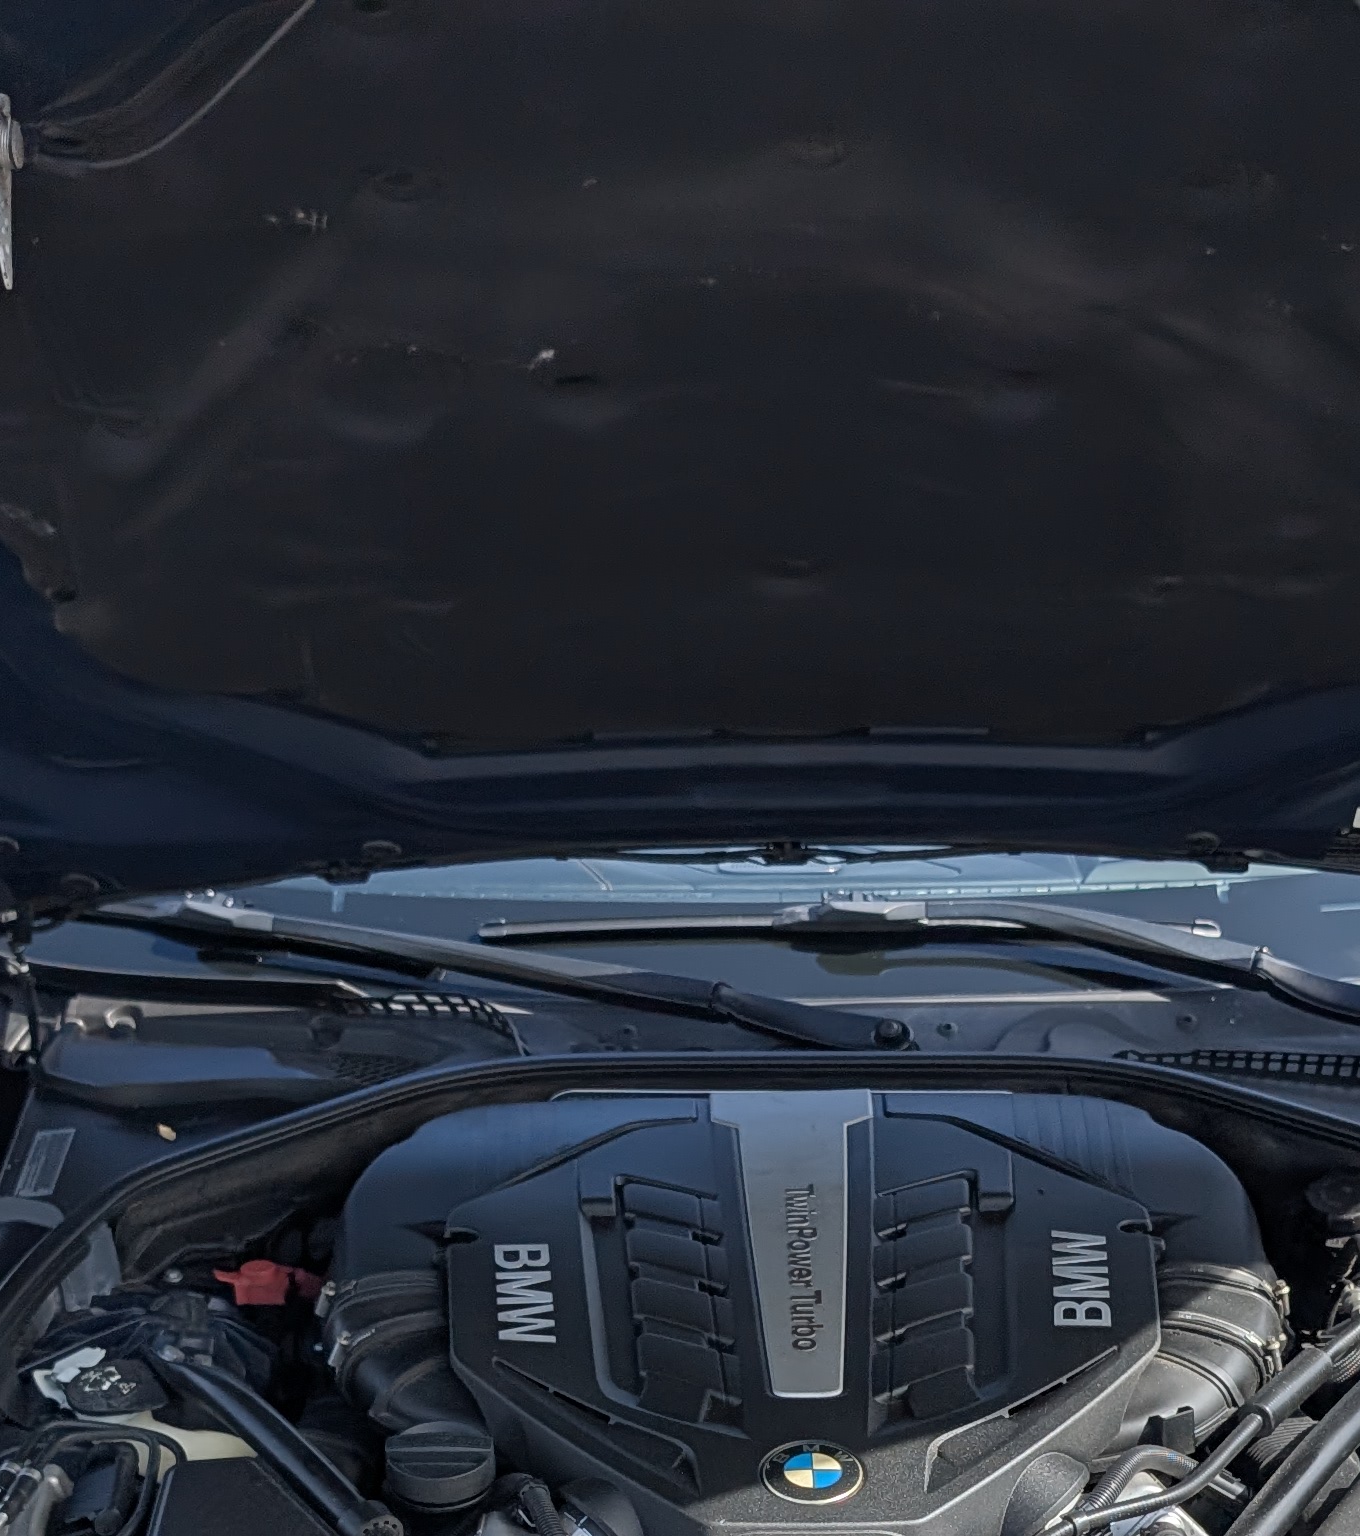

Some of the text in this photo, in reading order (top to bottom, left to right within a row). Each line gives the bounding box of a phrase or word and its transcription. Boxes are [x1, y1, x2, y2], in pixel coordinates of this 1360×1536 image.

[493, 1243, 557, 1344] BMW
[785, 1184, 824, 1351] TwinPower Turbo
[1050, 1229, 1112, 1328] BMW
[773, 1444, 853, 1463] BMW
